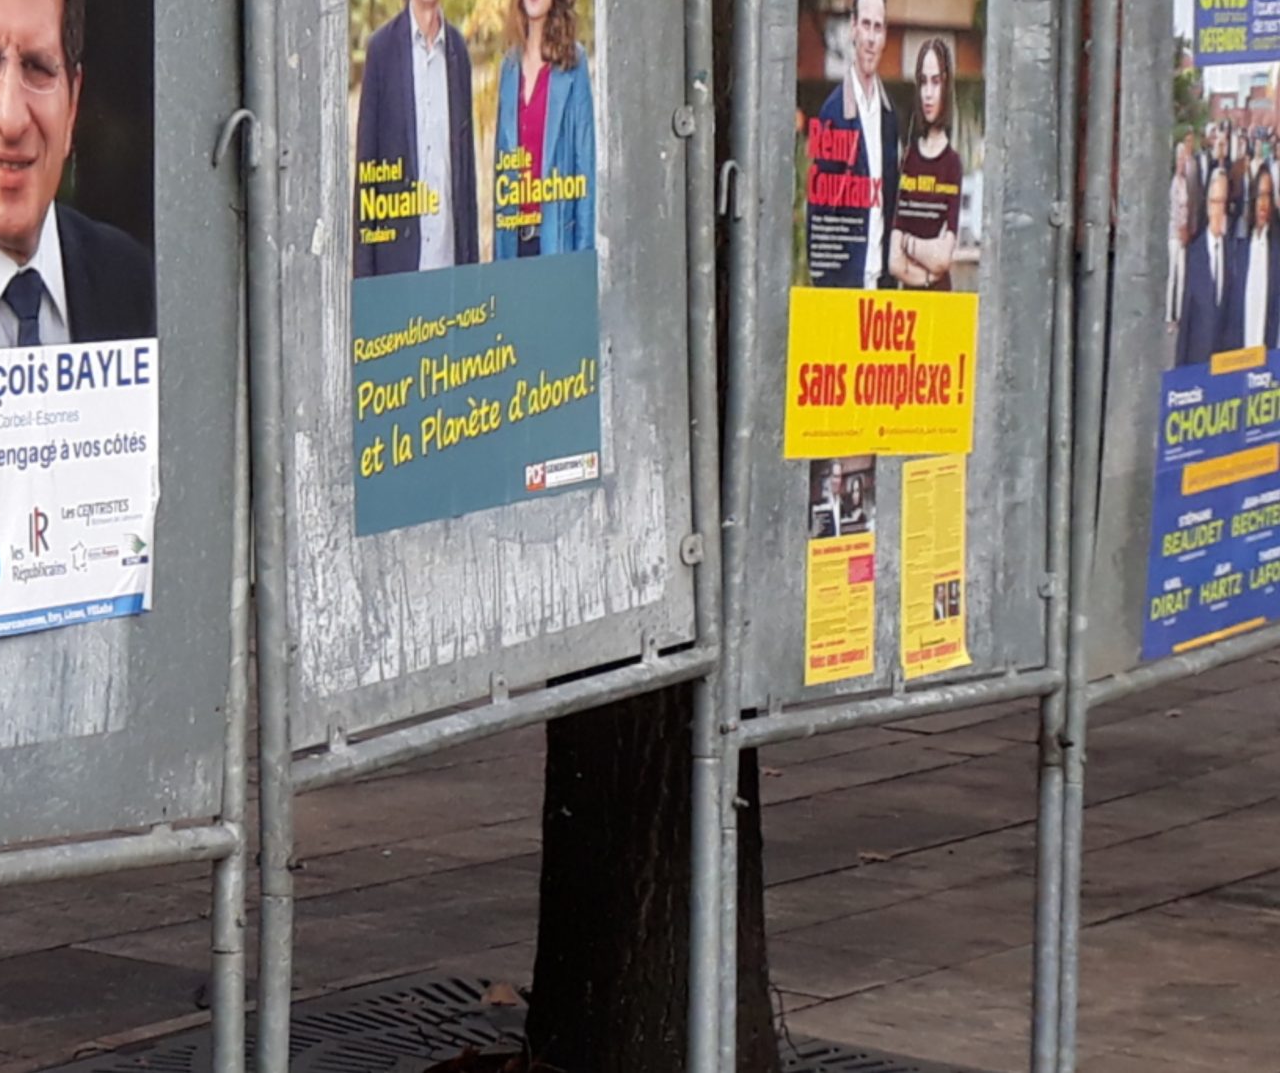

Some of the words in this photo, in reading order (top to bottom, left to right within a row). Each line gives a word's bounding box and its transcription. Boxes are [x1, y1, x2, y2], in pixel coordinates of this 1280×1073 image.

[359, 157, 403, 184] Michel
[360, 181, 440, 221] Nouaille
[859, 298, 917, 351] Votez
[57, 347, 150, 392] BAYLE
[357, 376, 414, 421] Pour
[420, 333, 517, 399] l'Humain
[797, 362, 847, 406] sans
[854, 353, 951, 410] complexe
[360, 436, 385, 478] et
[392, 423, 413, 467] la
[421, 396, 502, 456] Planète
[1166, 398, 1241, 445] CHOUAT
[60, 437, 70, 460] à
[73, 440, 101, 459] vos
[104, 433, 147, 458] côtés
[1150, 588, 1192, 621] DIRAT
[1200, 572, 1243, 606] HARTZ
